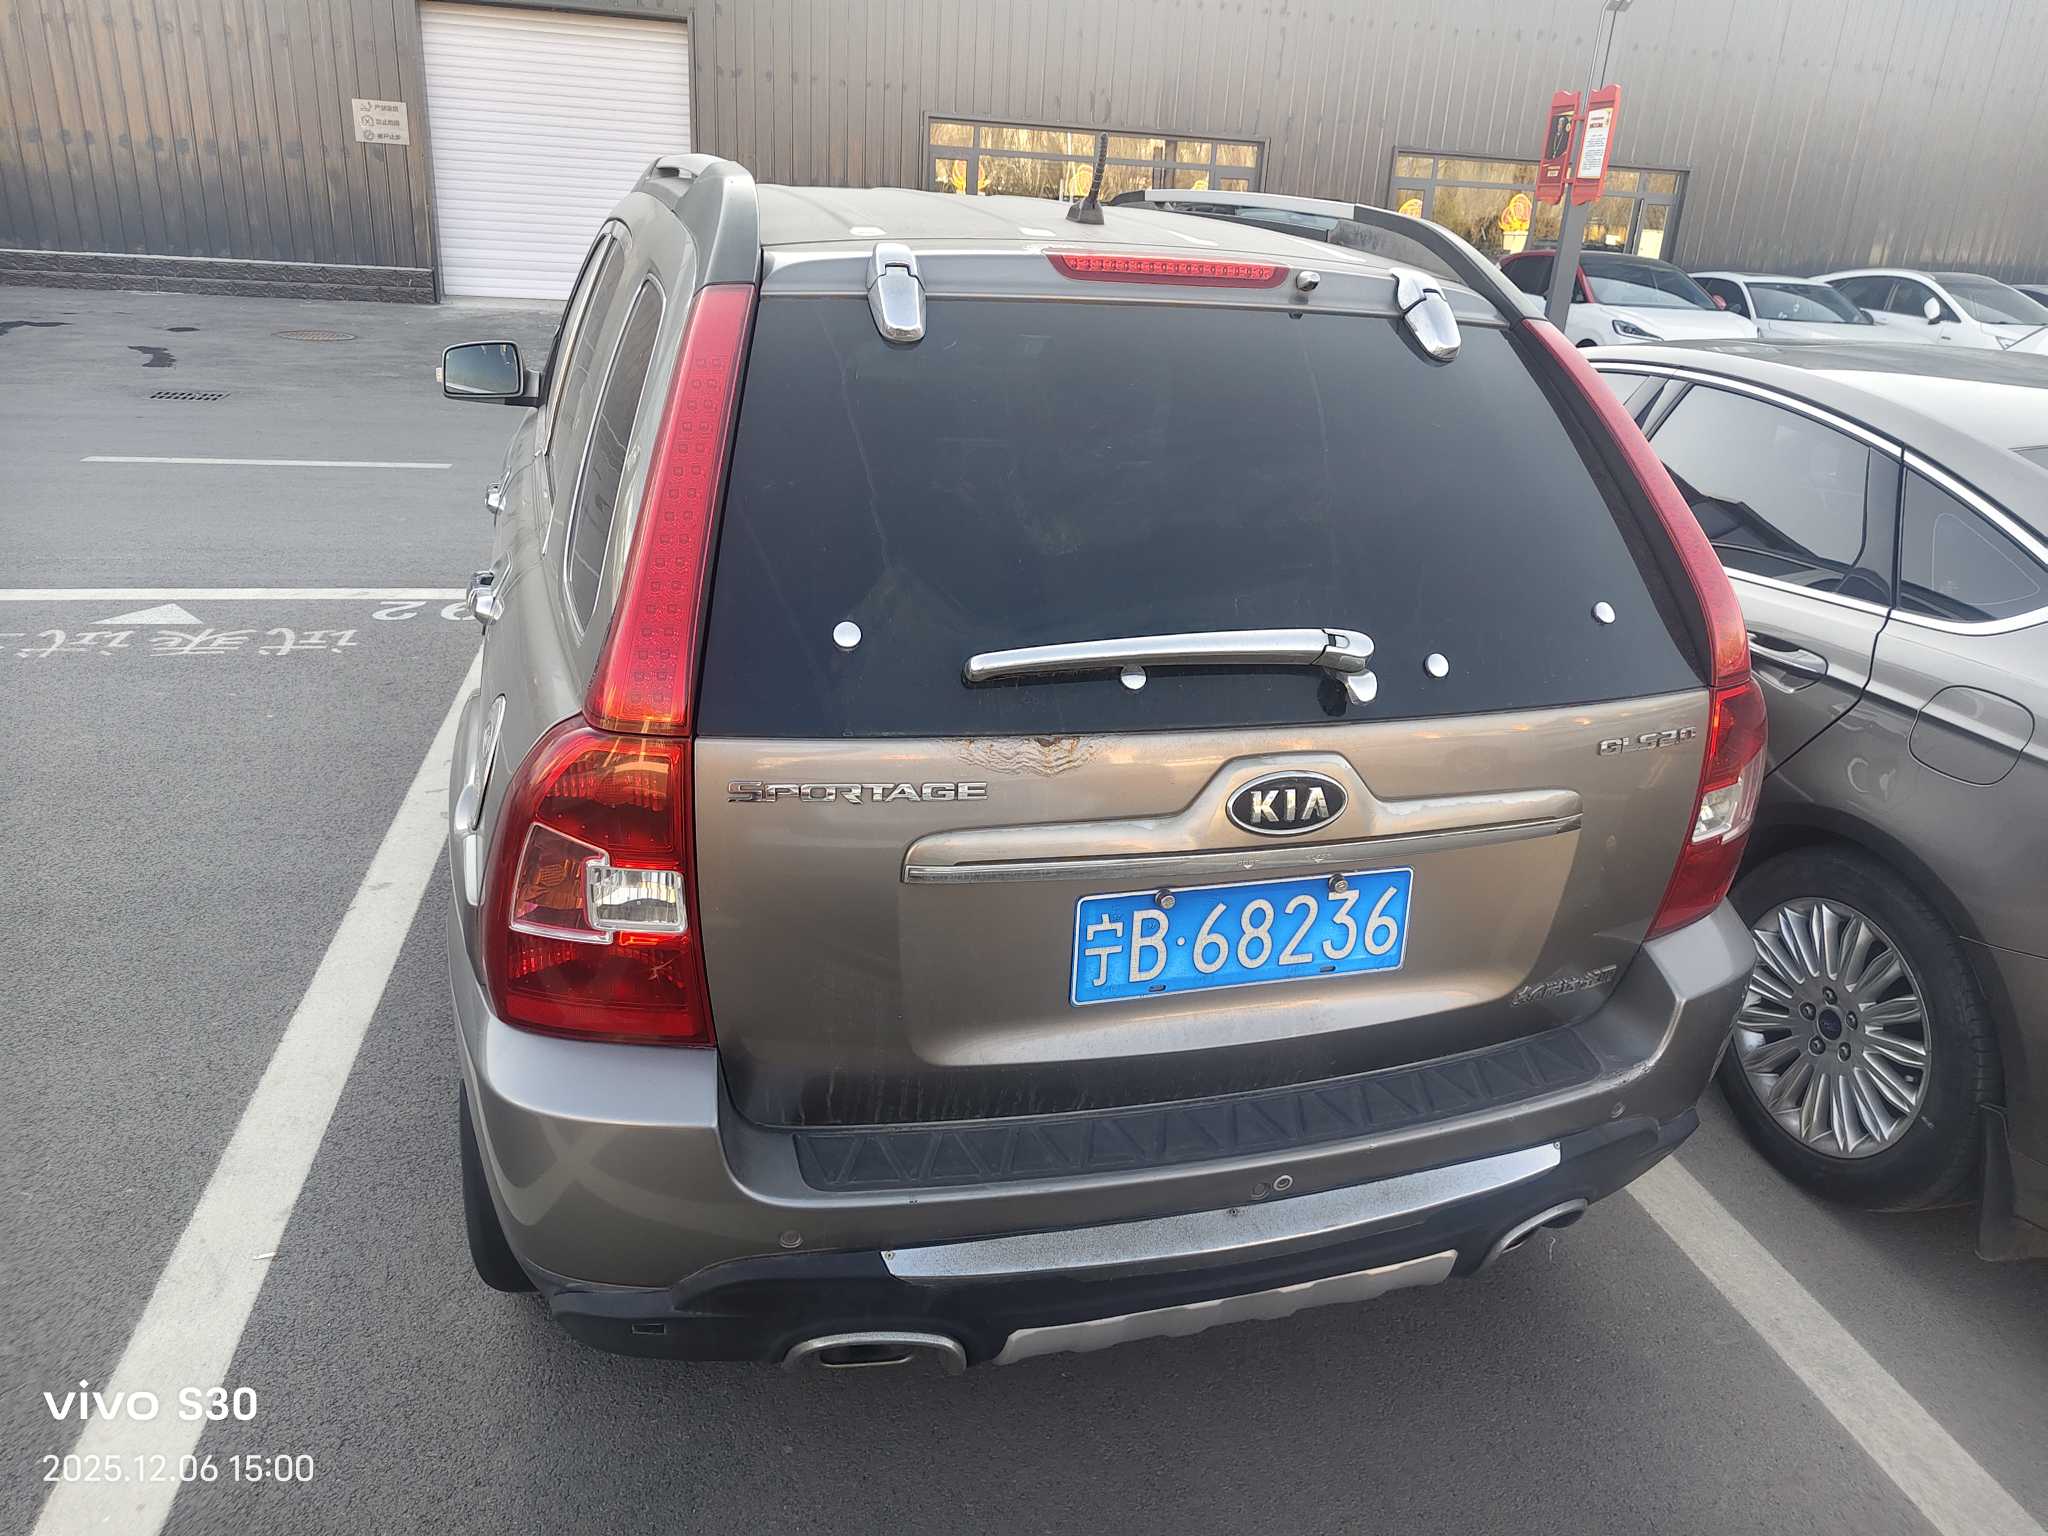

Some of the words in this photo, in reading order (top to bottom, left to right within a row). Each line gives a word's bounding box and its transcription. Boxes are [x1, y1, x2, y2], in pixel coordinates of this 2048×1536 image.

[0, 628, 358, 658] 试乘试
[727, 780, 989, 805] SPORTAGE
[1250, 786, 1332, 824] KIA
